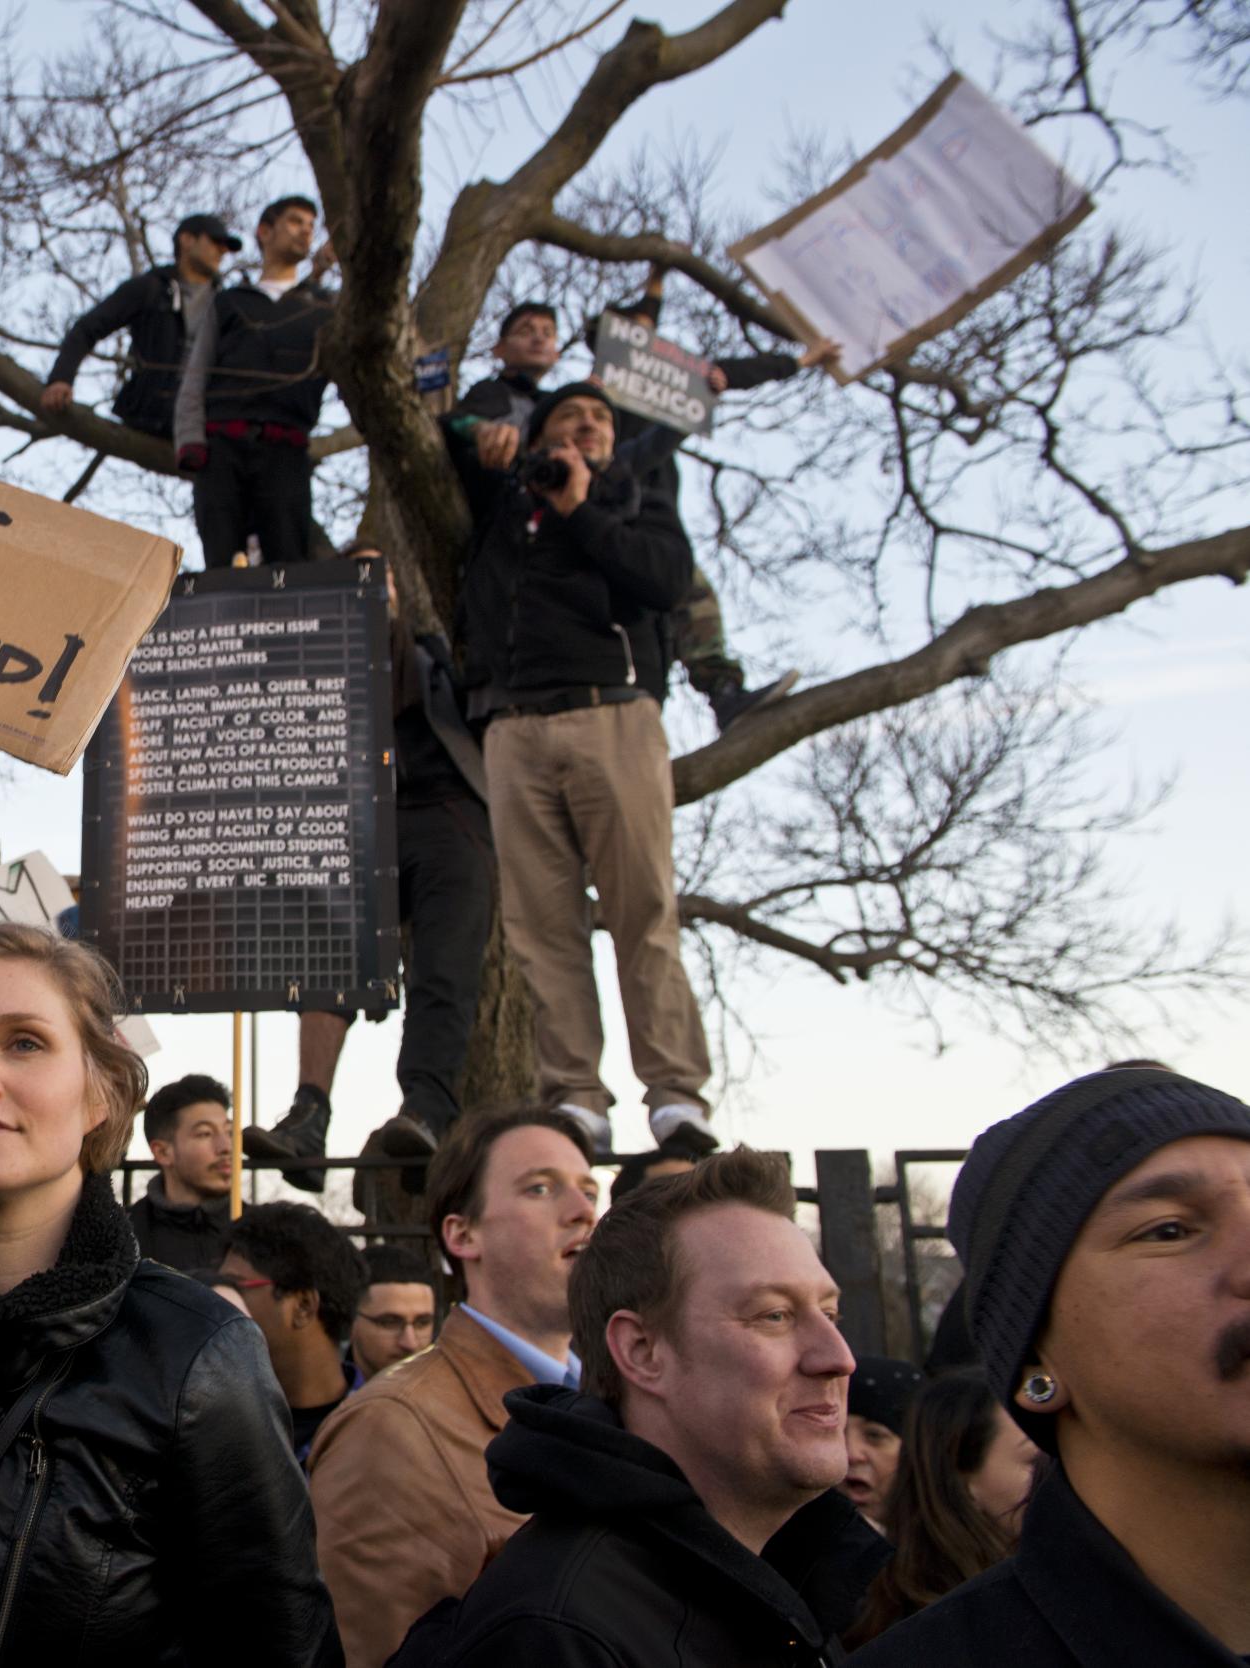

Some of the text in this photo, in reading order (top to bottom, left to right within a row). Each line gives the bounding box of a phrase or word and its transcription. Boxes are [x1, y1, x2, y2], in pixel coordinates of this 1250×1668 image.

[609, 315, 649, 347] NO
[629, 349, 690, 391] WITH
[603, 362, 706, 423] MEXICO
[157, 631, 168, 644] IS
[170, 629, 196, 642] NOT
[197, 628, 208, 639] A
[210, 625, 236, 637] FREE
[239, 621, 284, 636] SPEECH
[287, 619, 320, 633] ISSUE
[176, 643, 197, 657] DO
[200, 638, 243, 654] MATTER
[130, 652, 268, 674] YOUR SILENCE MATTERS
[315, 678, 346, 691] FIRST
[210, 696, 282, 712] IMMIGRANT
[173, 714, 225, 729] FACULTY
[233, 712, 251, 725] OF
[317, 709, 347, 722] AND
[129, 723, 347, 748] MORE HAVE VOICED CONCERNS
[129, 749, 170, 765] ABOUT
[171, 747, 203, 761] HOW
[205, 744, 236, 758] ACTS
[239, 743, 257, 756] OF
[315, 739, 347, 753] HATE
[179, 762, 207, 776] AND
[209, 758, 271, 773] VIOLENCE
[273, 756, 335, 770] PRODUCE
[336, 756, 348, 768] A
[128, 772, 339, 795] HOSTILE CLIMATE ON THIS CAMPUS
[127, 804, 349, 827] WHAT DO YOU HAVE TO SAY ABOUT
[127, 829, 170, 843] HIRING
[174, 826, 212, 840] MORE
[216, 823, 270, 837] FACULTY
[275, 822, 293, 835] OF
[127, 845, 180, 859] FUNDING
[182, 840, 286, 856] UNDOCUMENTED
[126, 860, 202, 877] SUPPORTING
[207, 857, 255, 871] SOCIAL
[320, 855, 350, 868] AND
[126, 871, 350, 892] ENSURING EVERY UIC STUDENT IS
[126, 894, 174, 909] HEARD?
